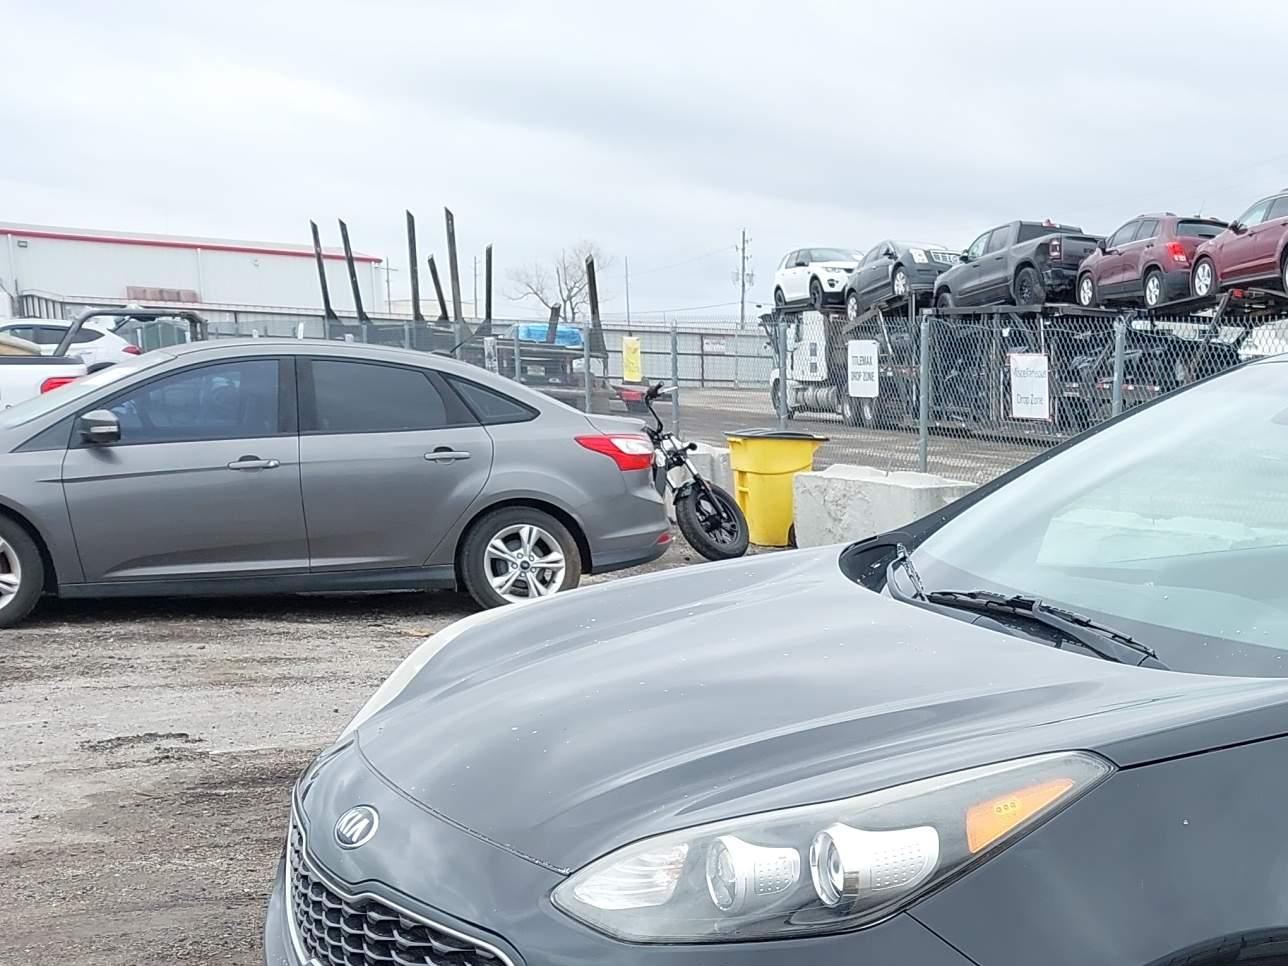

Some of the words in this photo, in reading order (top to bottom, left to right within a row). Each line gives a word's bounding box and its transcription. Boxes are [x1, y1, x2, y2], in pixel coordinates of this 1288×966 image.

[850, 371, 862, 382] DROP
[863, 371, 875, 382] ZONE
[1016, 393, 1030, 406] Drop
[1031, 393, 1045, 405] Zone
[336, 808, 374, 844] KIA
